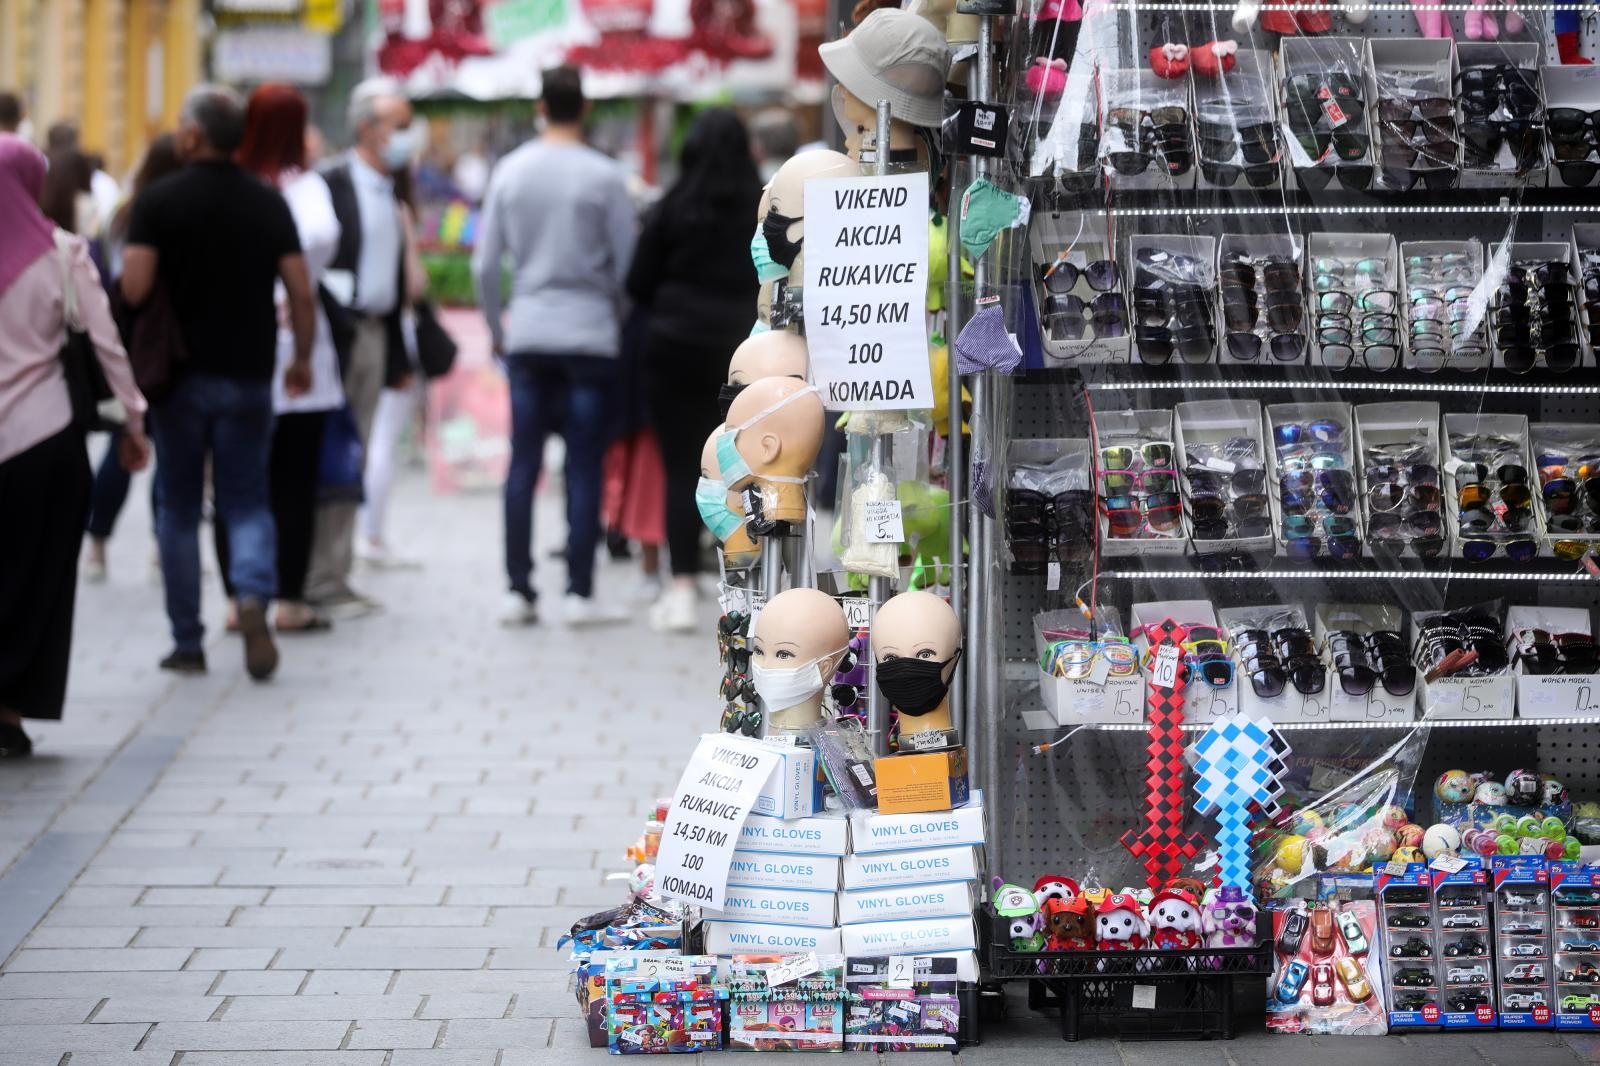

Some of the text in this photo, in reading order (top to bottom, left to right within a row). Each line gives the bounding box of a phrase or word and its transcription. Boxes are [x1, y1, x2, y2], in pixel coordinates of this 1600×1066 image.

[834, 187, 908, 210] VIKEND
[835, 224, 902, 247] AKCIJA
[818, 262, 917, 287] RUKAVICE
[820, 302, 909, 329] 14,50 KM
[848, 342, 883, 364] 100
[829, 379, 915, 402] KOMADA
[711, 746, 759, 770] VIKEND
[698, 771, 743, 793] AKCIJA
[679, 794, 742, 821] RUKAVICE
[673, 821, 728, 848] 14,50 KM
[741, 826, 822, 841] INYL GLOVES
[871, 820, 959, 838] VINYL GLOVES
[681, 853, 704, 871] 100
[764, 863, 814, 876] GLOVES
[862, 857, 950, 874] VINYL GLOVES
[662, 875, 714, 903] KOMADA
[724, 897, 810, 912] VINYL GLOVES
[857, 893, 945, 910] VINYL GLOVES
[729, 933, 817, 948] VINYL GLOVES
[862, 927, 950, 944] VINYL GLOVES
[894, 963, 910, 981] 2
